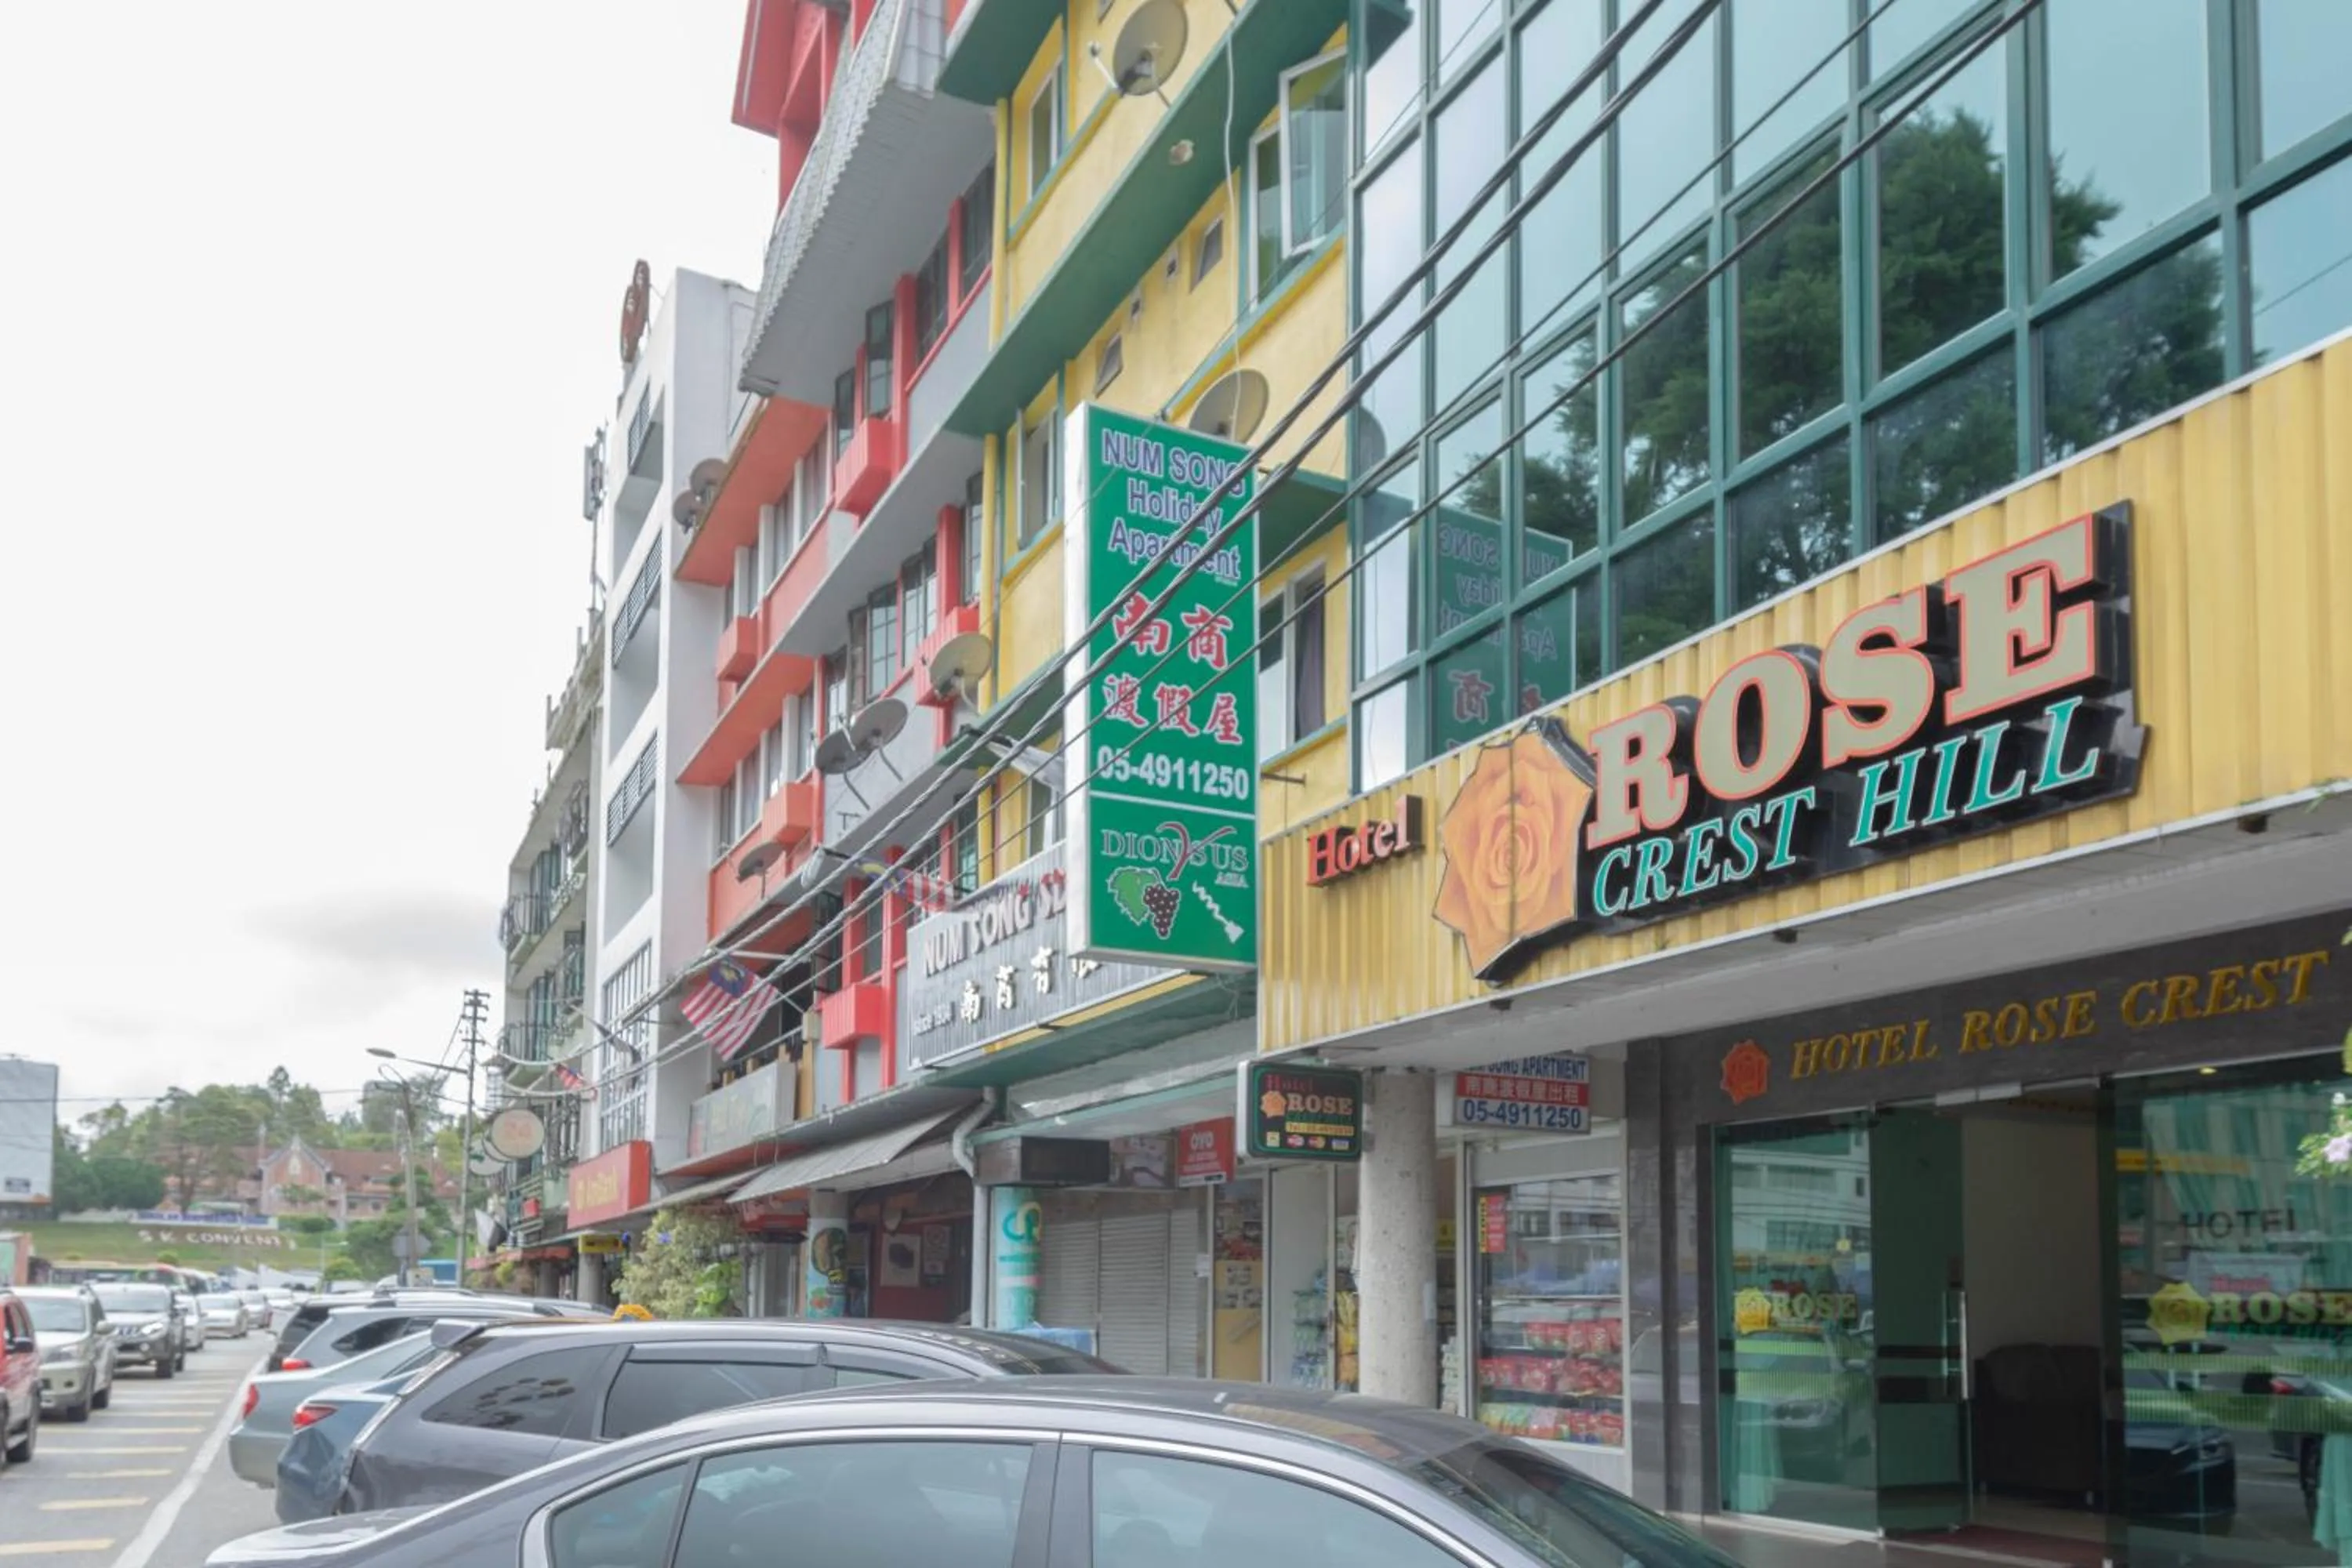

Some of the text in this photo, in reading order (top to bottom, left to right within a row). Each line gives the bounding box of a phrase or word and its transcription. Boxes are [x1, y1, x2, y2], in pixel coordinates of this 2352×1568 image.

[1102, 428, 1164, 477] NUM
[1102, 673, 1243, 745] 渡假屋
[1587, 512, 2099, 850] ROSE
[1098, 745, 1249, 800] 05-4911250
[1592, 696, 2100, 916] CREST HILL
[1101, 821, 1249, 881] DIONYSUS
[1306, 794, 1411, 887] Hotel
[924, 920, 965, 978] NUM
[969, 884, 1031, 953] SONG
[1790, 950, 2330, 1080] HOTEL ROSE CREST
[1287, 1092, 1353, 1115] ROSE
[1464, 1099, 1581, 1129] 05-4911250
[2209, 1291, 2352, 1325] ROSE
